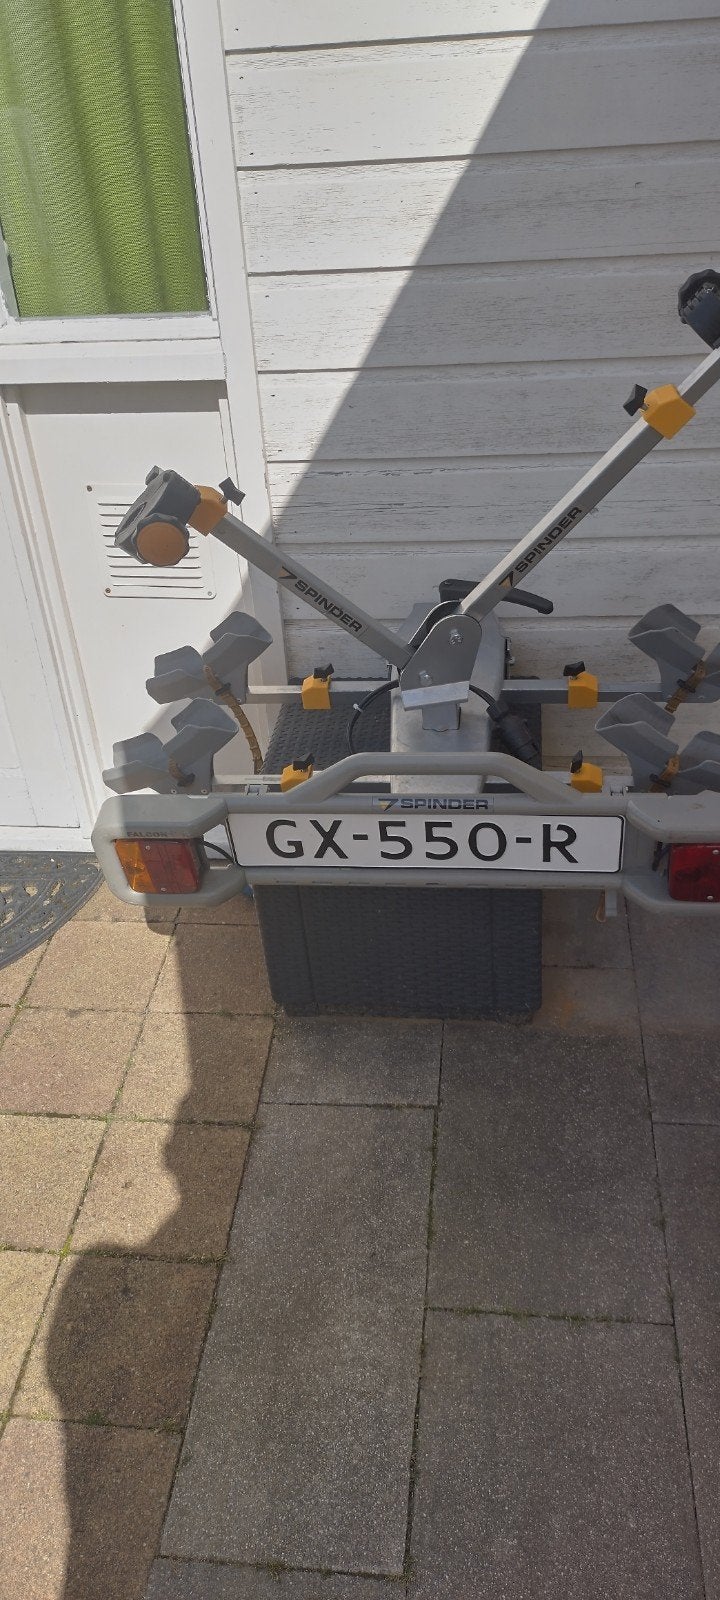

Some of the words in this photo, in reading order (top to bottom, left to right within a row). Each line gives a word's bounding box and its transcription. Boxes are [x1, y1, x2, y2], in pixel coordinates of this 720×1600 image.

[515, 506, 582, 573] SPINDER
[294, 579, 363, 633] SPINDER
[400, 798, 489, 810] SPINDER
[265, 819, 579, 864] GX-550-R
